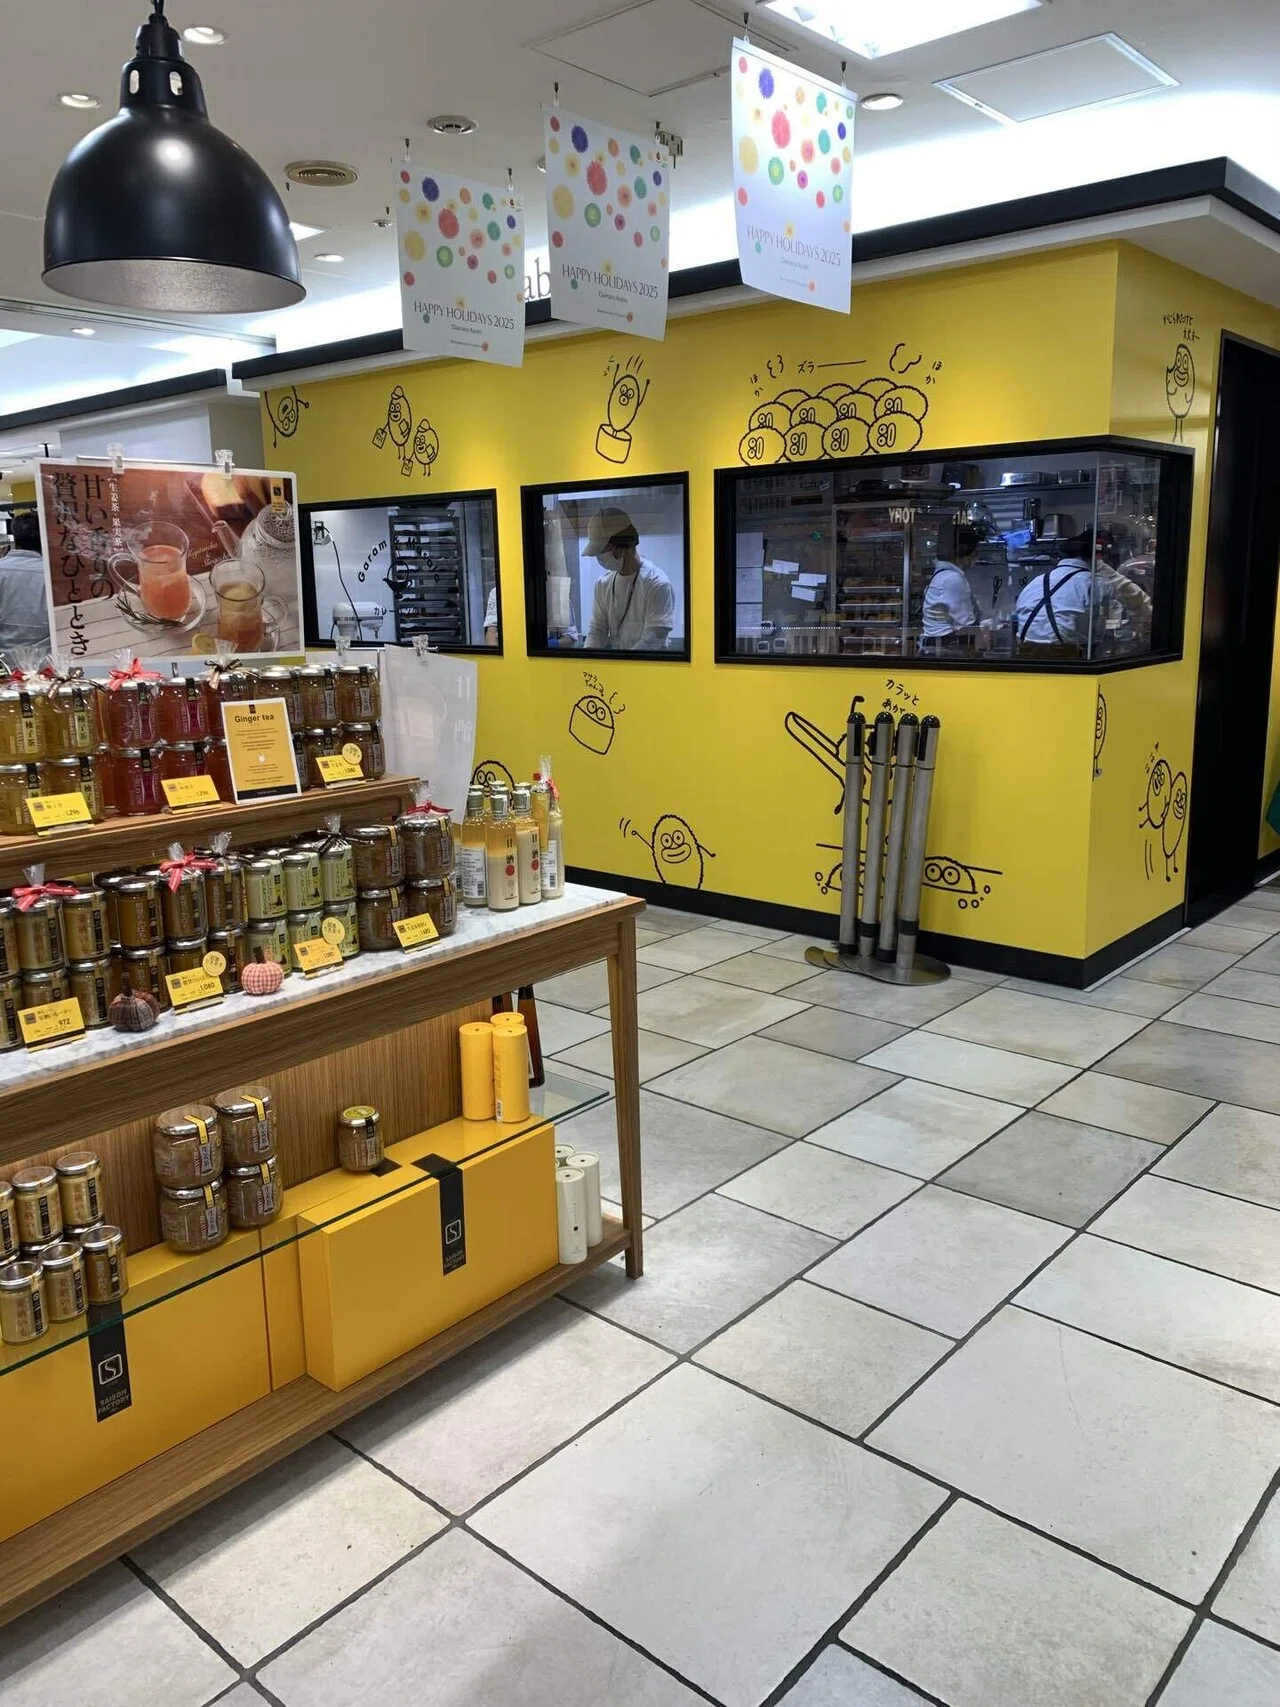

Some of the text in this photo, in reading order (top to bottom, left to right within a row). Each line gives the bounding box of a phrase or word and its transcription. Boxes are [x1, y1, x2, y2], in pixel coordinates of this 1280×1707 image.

[747, 223, 841, 267] HAPPY HOLIDAYS 2025
[562, 264, 659, 299] HAPPY HOLIDAYS 2025
[414, 300, 515, 330] HAPPY HOLIDAYS 2025
[358, 540, 387, 583] Garam
[886, 679, 920, 706] カラッと
[234, 715, 260, 724] Ginger
[58, 1018, 71, 1027] 972
[98, 1393, 130, 1415] FACTORY
[100, 1388, 127, 1406] SAISON
